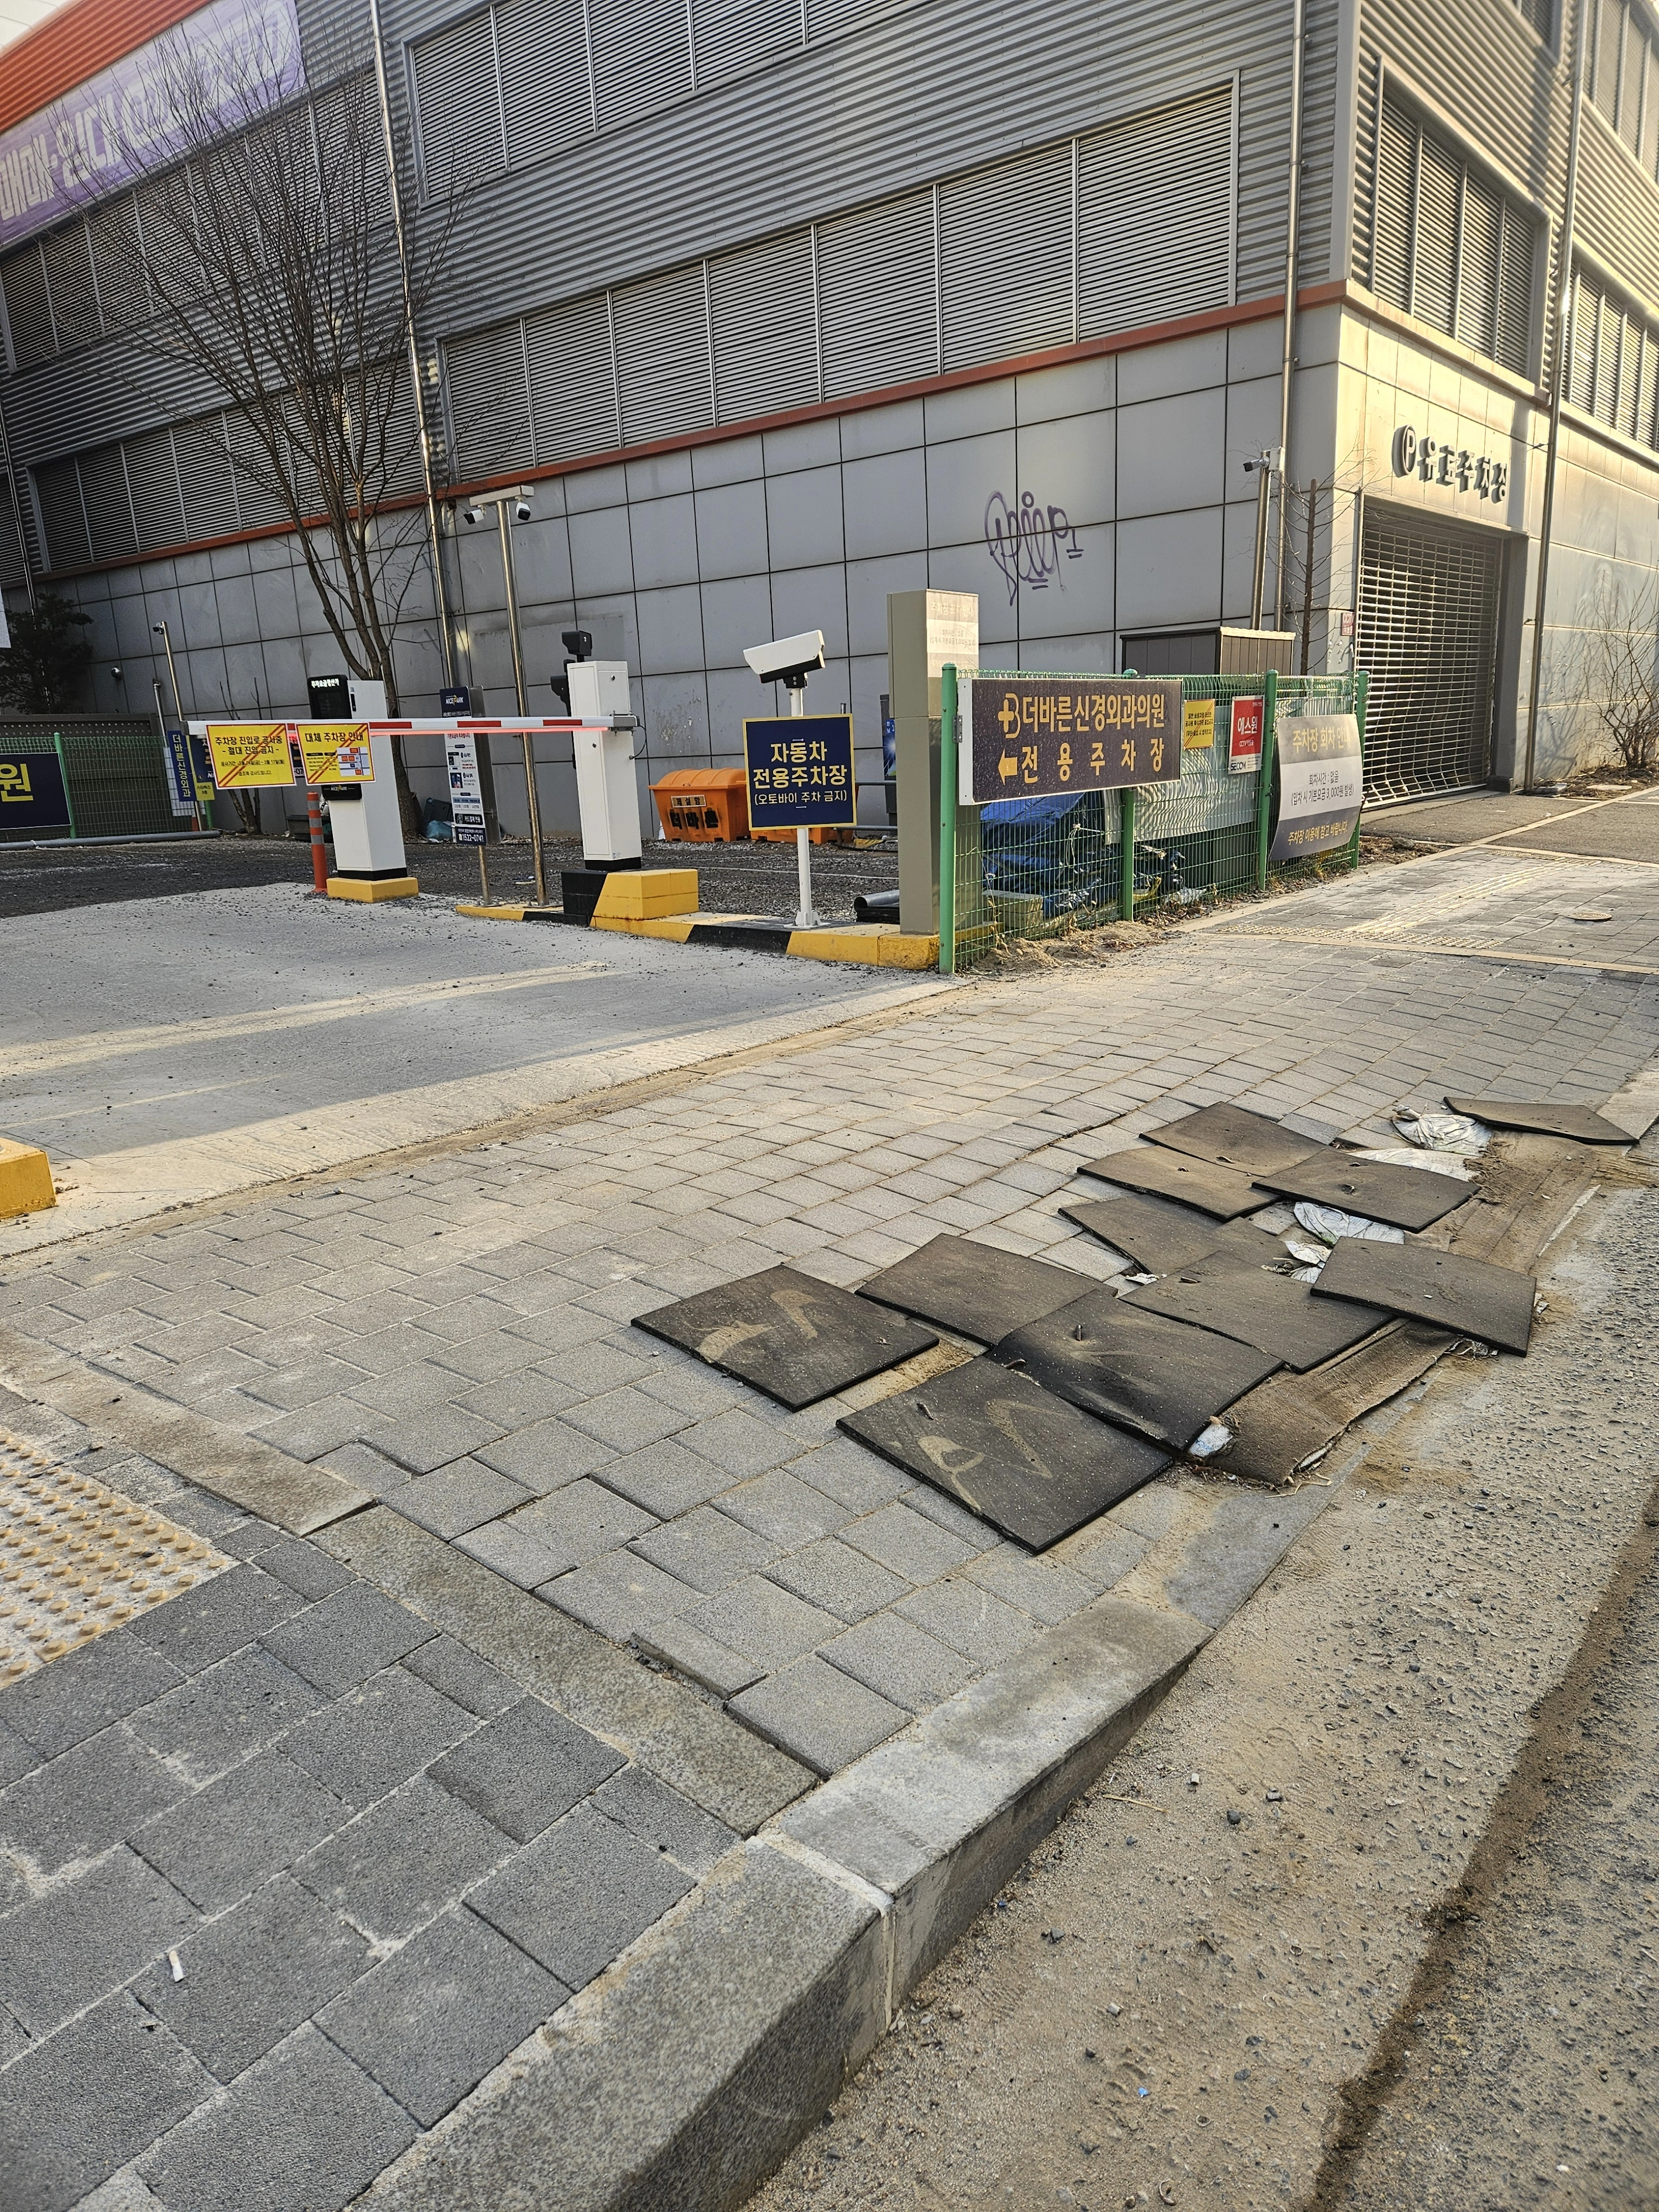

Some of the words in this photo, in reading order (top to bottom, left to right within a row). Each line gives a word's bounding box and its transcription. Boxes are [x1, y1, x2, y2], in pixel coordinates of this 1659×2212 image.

[1417, 436, 1507, 504] 유료주차장
[1238, 716, 1258, 735] 에스원
[215, 736, 237, 745] 주차장
[239, 735, 260, 745] 진입로
[262, 735, 283, 744] 공사중
[305, 733, 321, 742] 대체
[324, 733, 346, 742] 주차장
[348, 732, 363, 742] 안내
[1293, 727, 1318, 753] 주차장
[1320, 727, 1335, 750] 회차
[1337, 726, 1350, 749] 안내
[228, 747, 242, 755] 절대
[244, 747, 258, 755] 진입
[260, 745, 274, 754] 금지
[770, 741, 827, 763] 자동차
[1230, 761, 1246, 770] SECOM
[0, 764, 33, 802] 원
[753, 765, 847, 789] 전용주차장
[1309, 771, 1326, 786] 회차시간
[1331, 770, 1338, 784] 없음
[754, 792, 797, 805] (오토바이
[801, 791, 821, 802] 주차
[823, 790, 847, 802] 금지)
[1291, 791, 1302, 806] (입차
[1303, 790, 1308, 803] 시
[1308, 788, 1326, 802] 기본요금
[1327, 785, 1344, 800] 3,000원
[1344, 783, 1354, 796] 발생)
[462, 834, 484, 842] 1522-0741
[1288, 830, 1305, 846] 주차장
